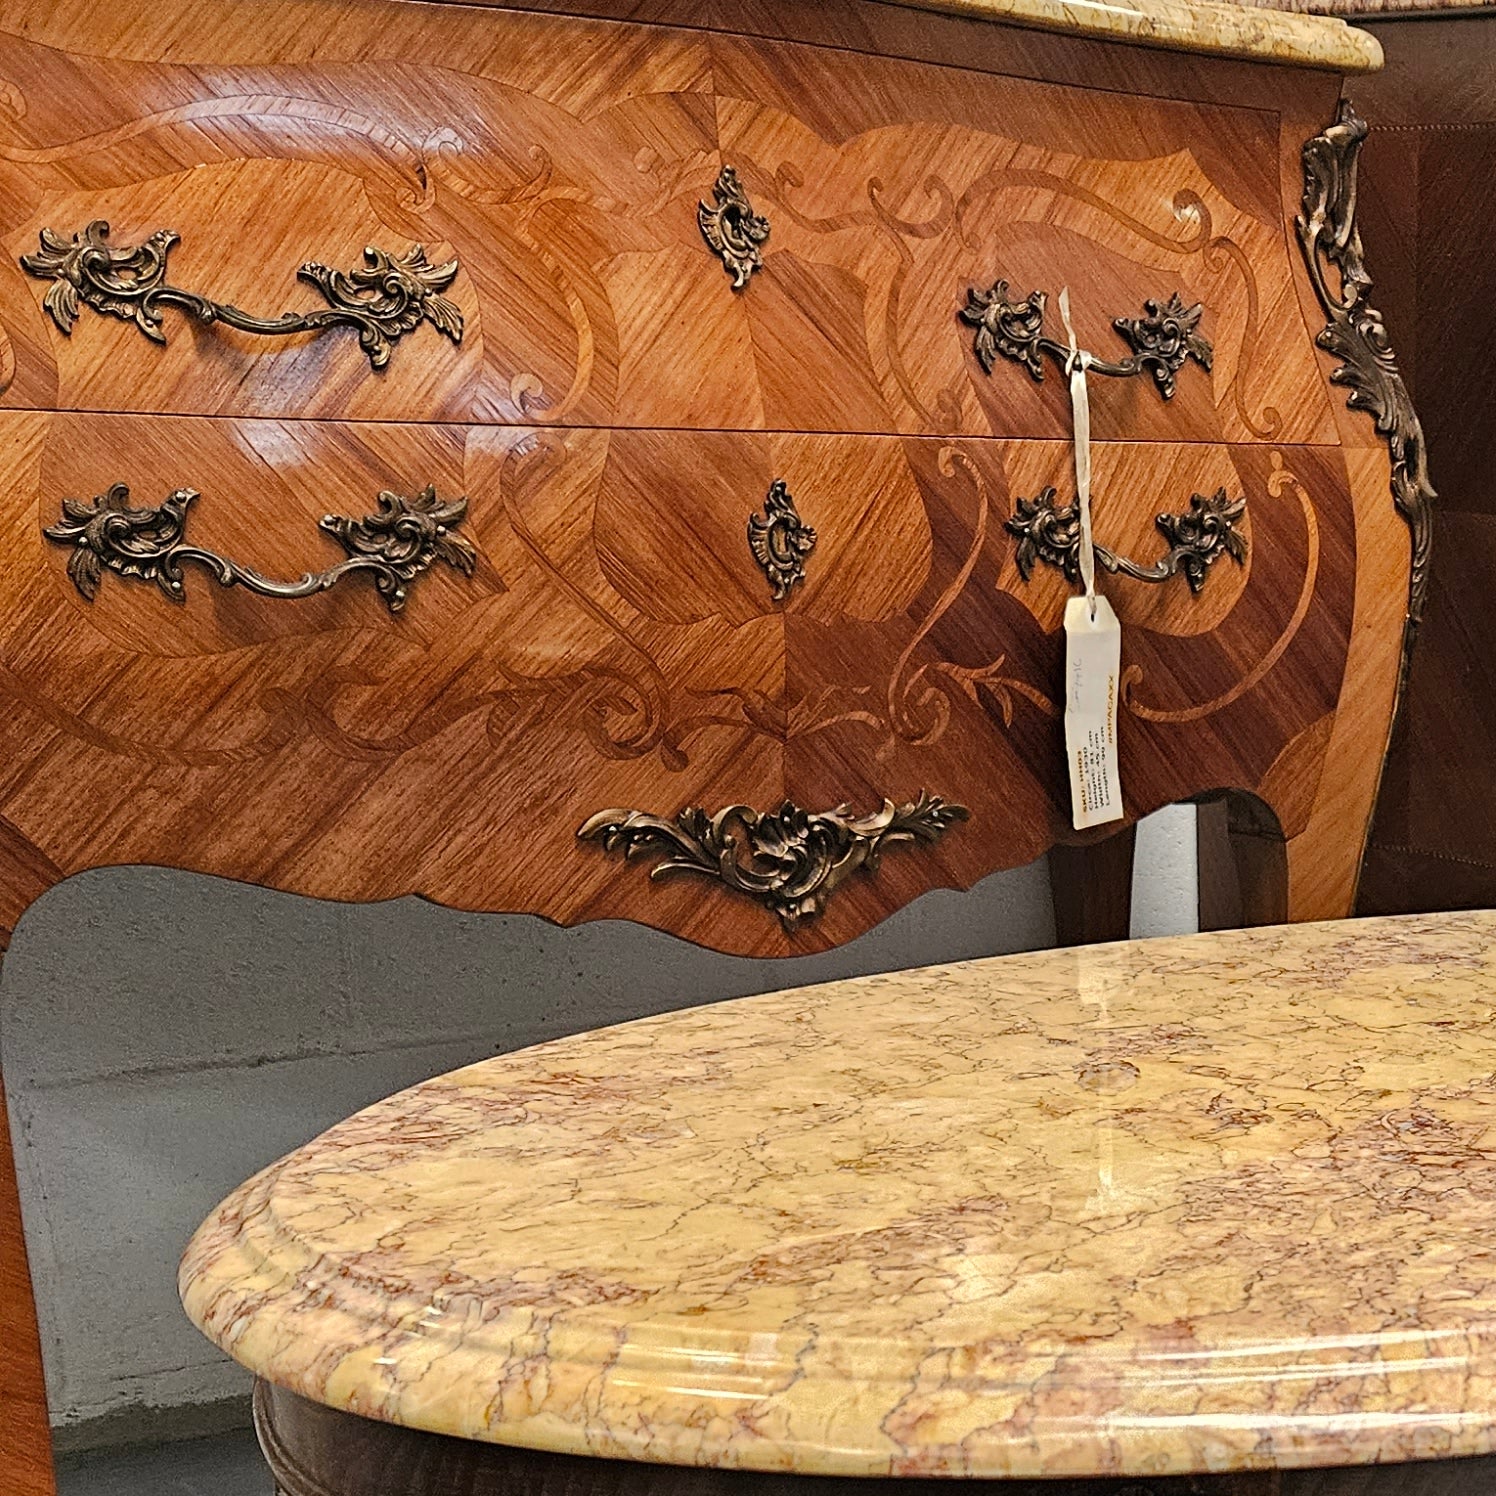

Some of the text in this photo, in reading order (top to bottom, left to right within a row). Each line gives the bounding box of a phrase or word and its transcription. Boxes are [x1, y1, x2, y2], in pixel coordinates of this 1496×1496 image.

[1088, 730, 1094, 748] cm
[1094, 732, 1100, 750] cm
[1100, 726, 1106, 743] cm
[1095, 753, 1100, 767] 45
[1091, 768, 1099, 809] Height:
[1102, 764, 1110, 806] Length:
